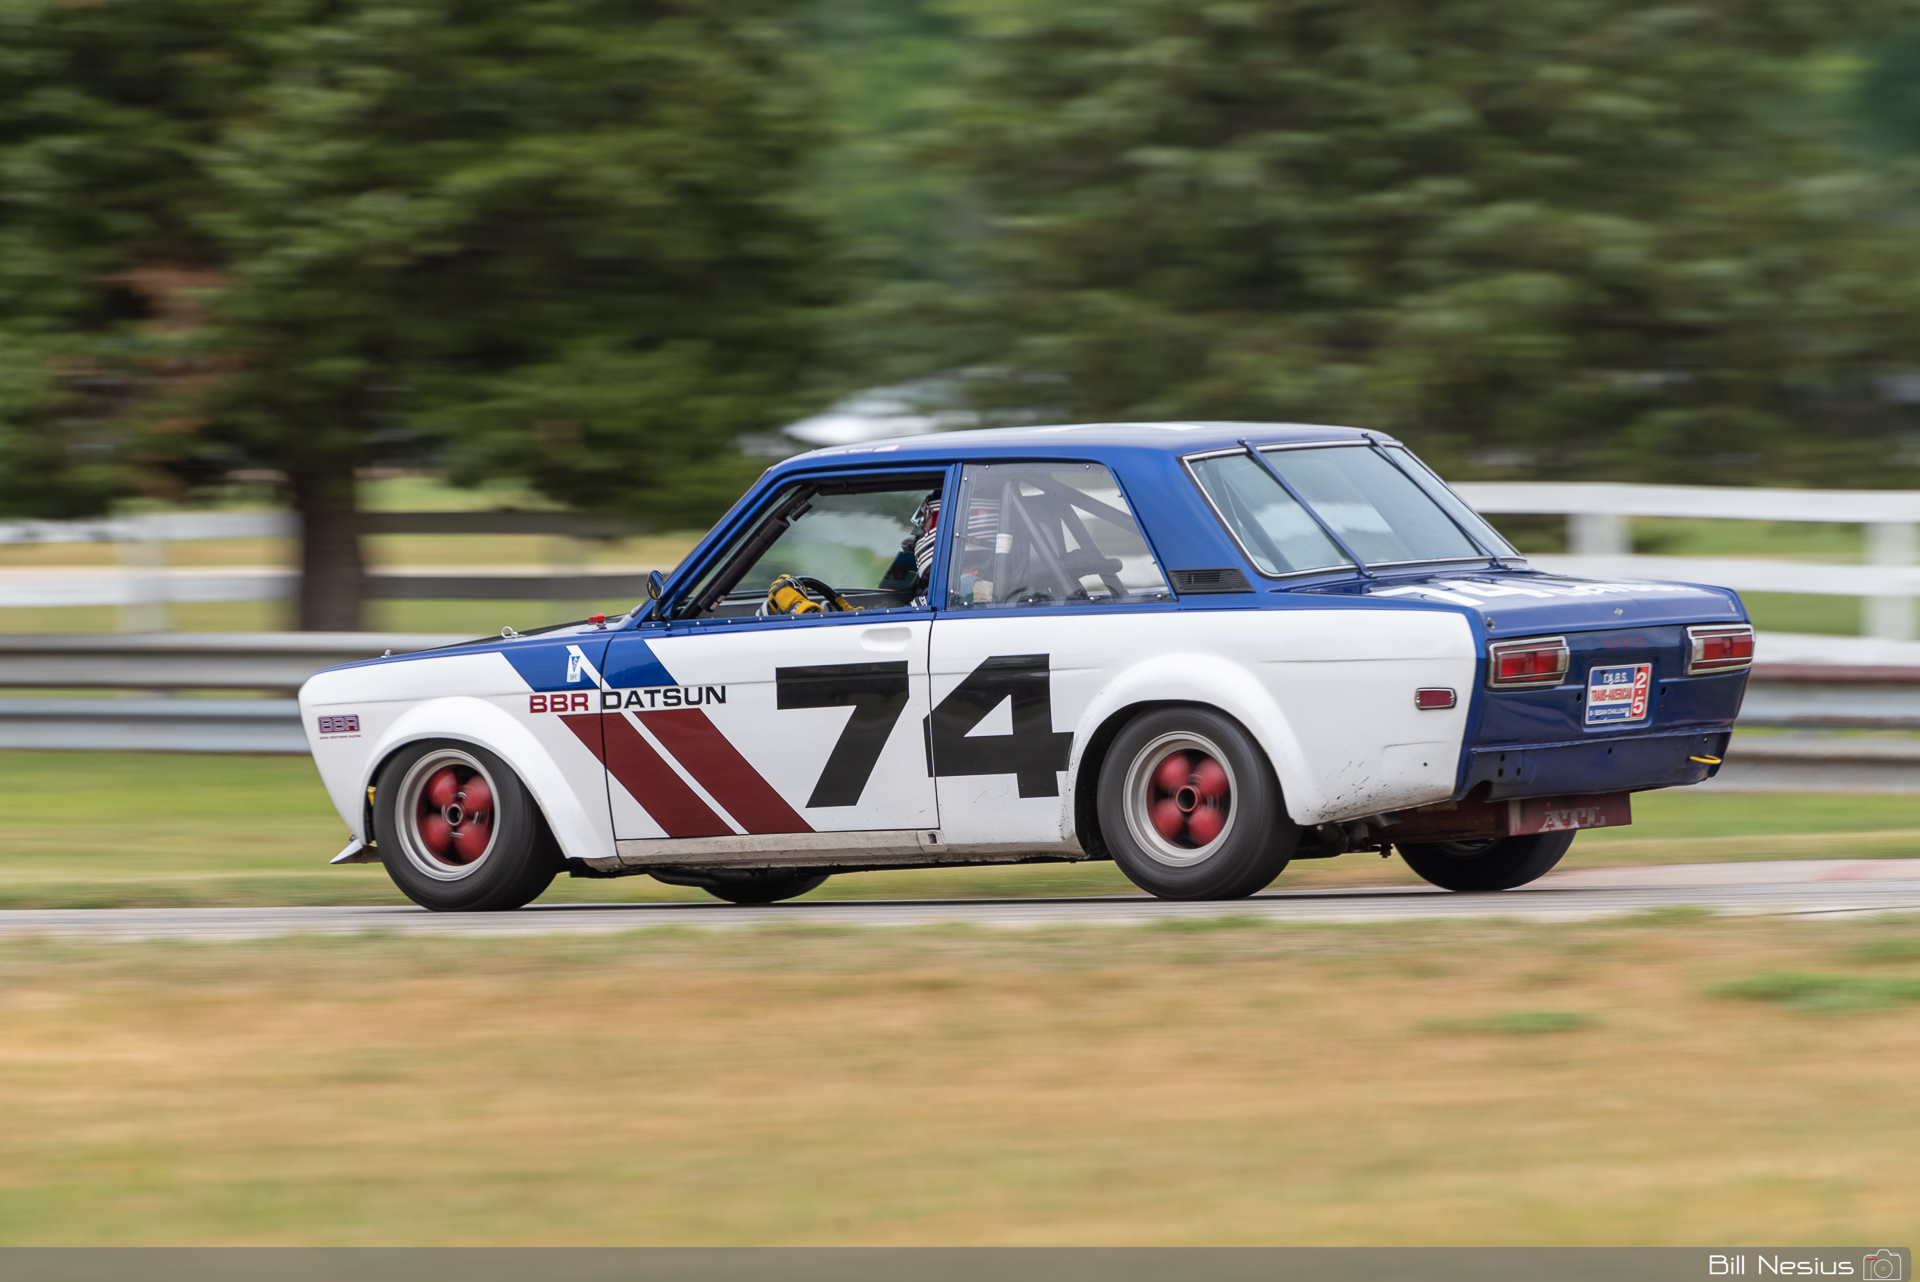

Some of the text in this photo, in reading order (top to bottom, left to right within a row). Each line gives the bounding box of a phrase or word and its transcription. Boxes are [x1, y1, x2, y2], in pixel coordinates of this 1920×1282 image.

[529, 685, 726, 713] BBR DATSUN
[320, 716, 358, 731] BBR
[775, 653, 1075, 809] 74
[1538, 806, 1606, 832] ATL
